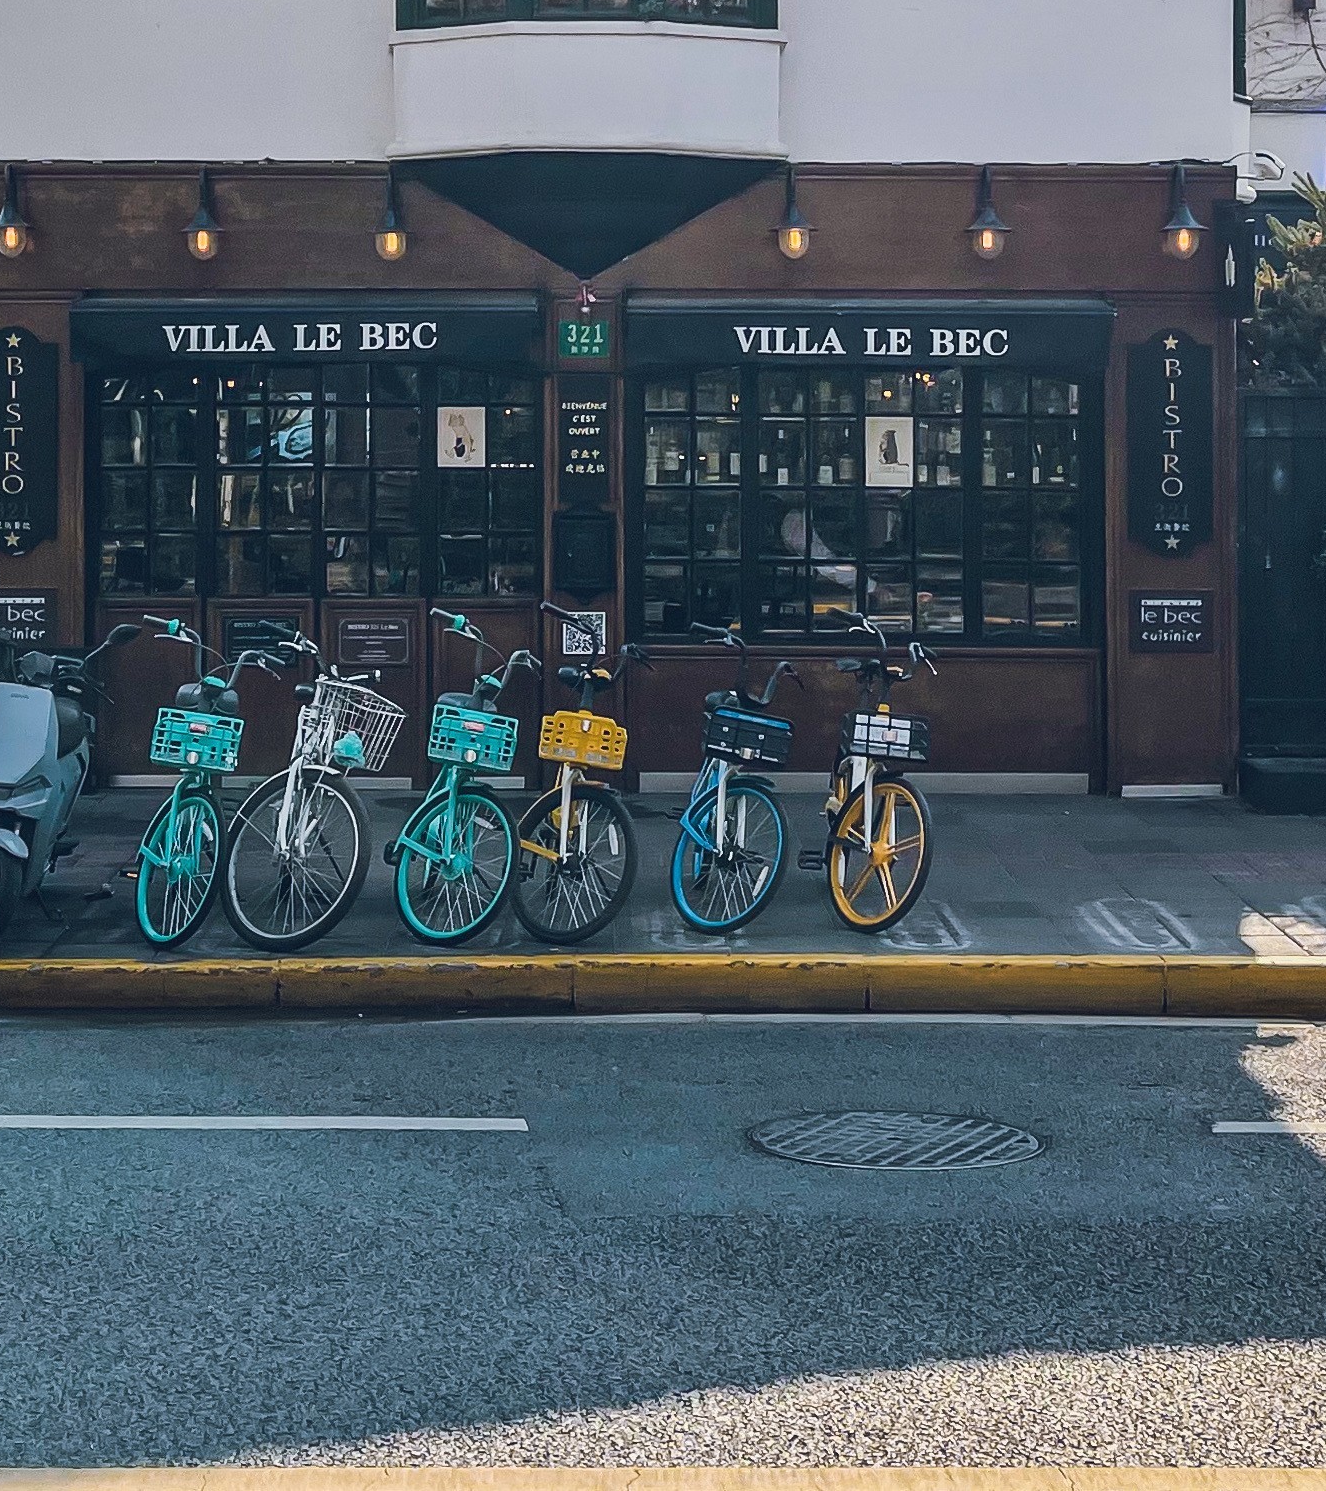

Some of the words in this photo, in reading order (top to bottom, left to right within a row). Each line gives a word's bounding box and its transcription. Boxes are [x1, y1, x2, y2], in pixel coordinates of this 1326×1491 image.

[162, 324, 275, 352] VILLA
[293, 323, 341, 352] LE
[359, 322, 438, 351] BEC
[567, 323, 604, 344] 321
[733, 326, 846, 355] VILLA
[863, 327, 912, 356] LE
[929, 328, 1009, 357] BEC
[2, 356, 24, 495] BISTRO
[1161, 358, 1183, 497] BISTRO
[7, 605, 46, 622] bec
[1141, 606, 1158, 624] le
[1164, 607, 1202, 624] bec
[1141, 629, 1202, 642] cuisinier
